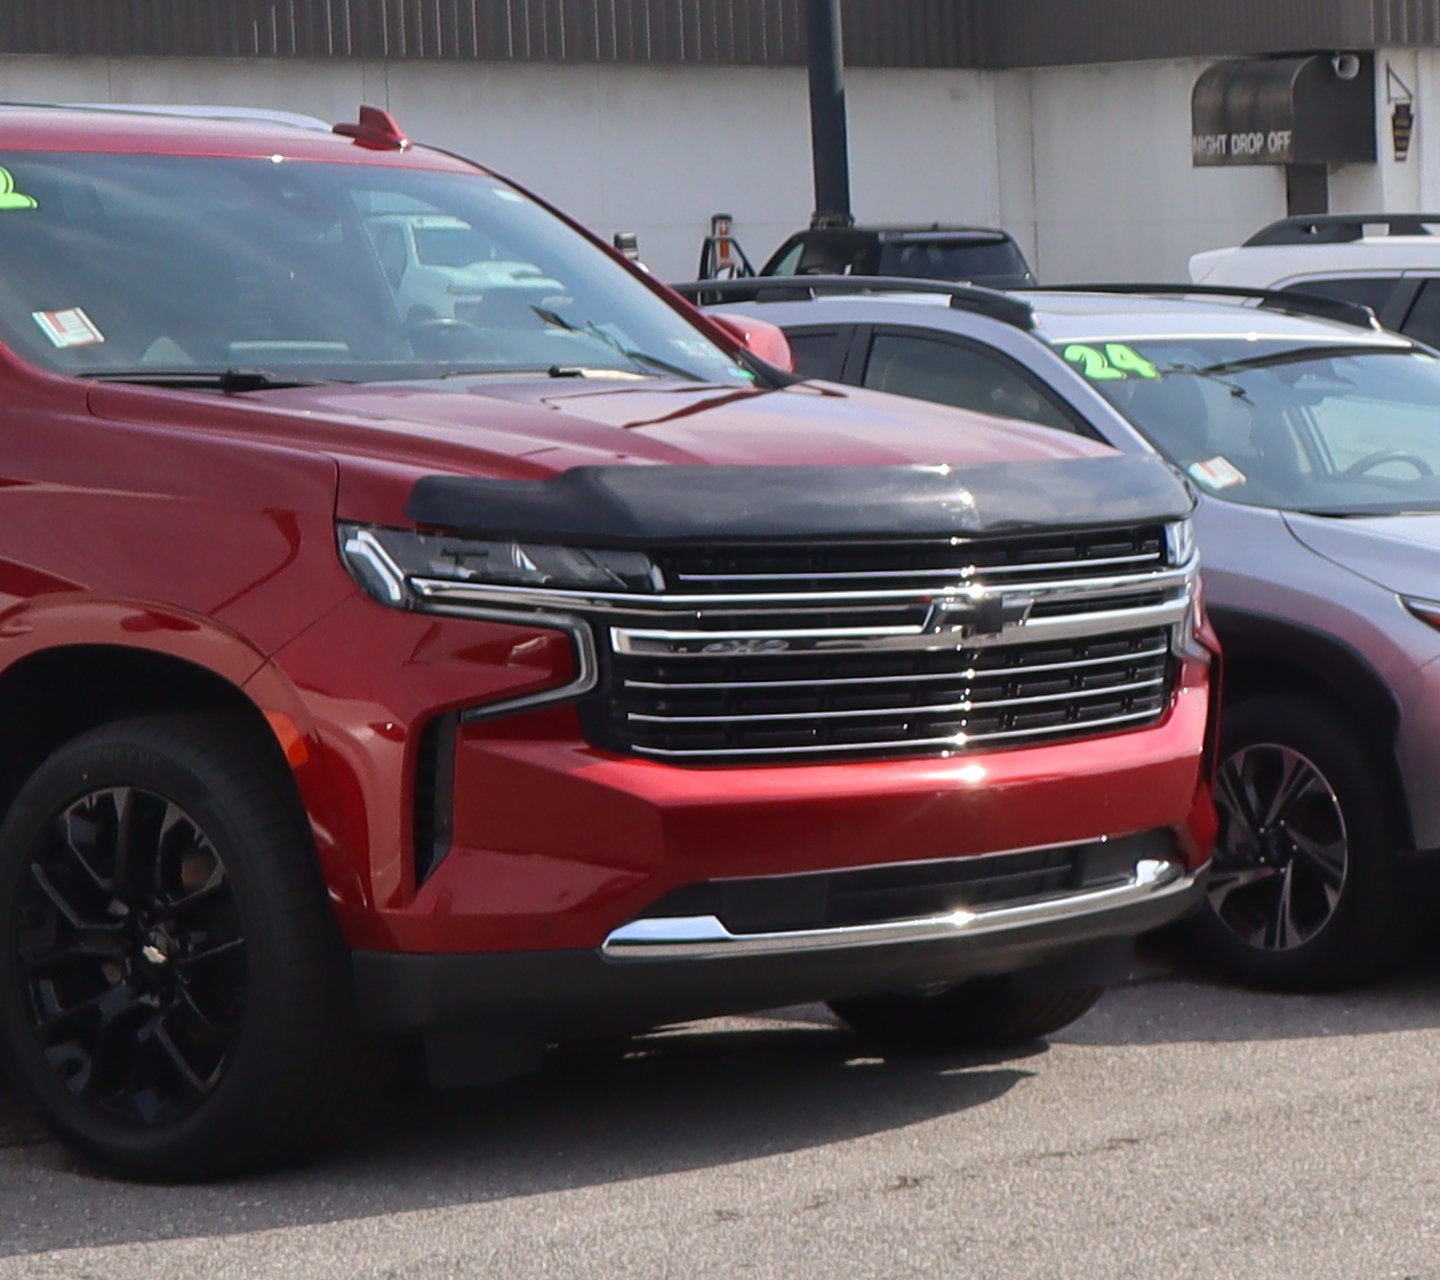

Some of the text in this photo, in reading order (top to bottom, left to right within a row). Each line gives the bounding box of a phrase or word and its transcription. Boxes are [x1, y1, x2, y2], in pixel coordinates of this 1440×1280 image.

[1231, 132, 1264, 155] DROP
[1267, 130, 1292, 154] OFF
[1064, 344, 1162, 380] 24
